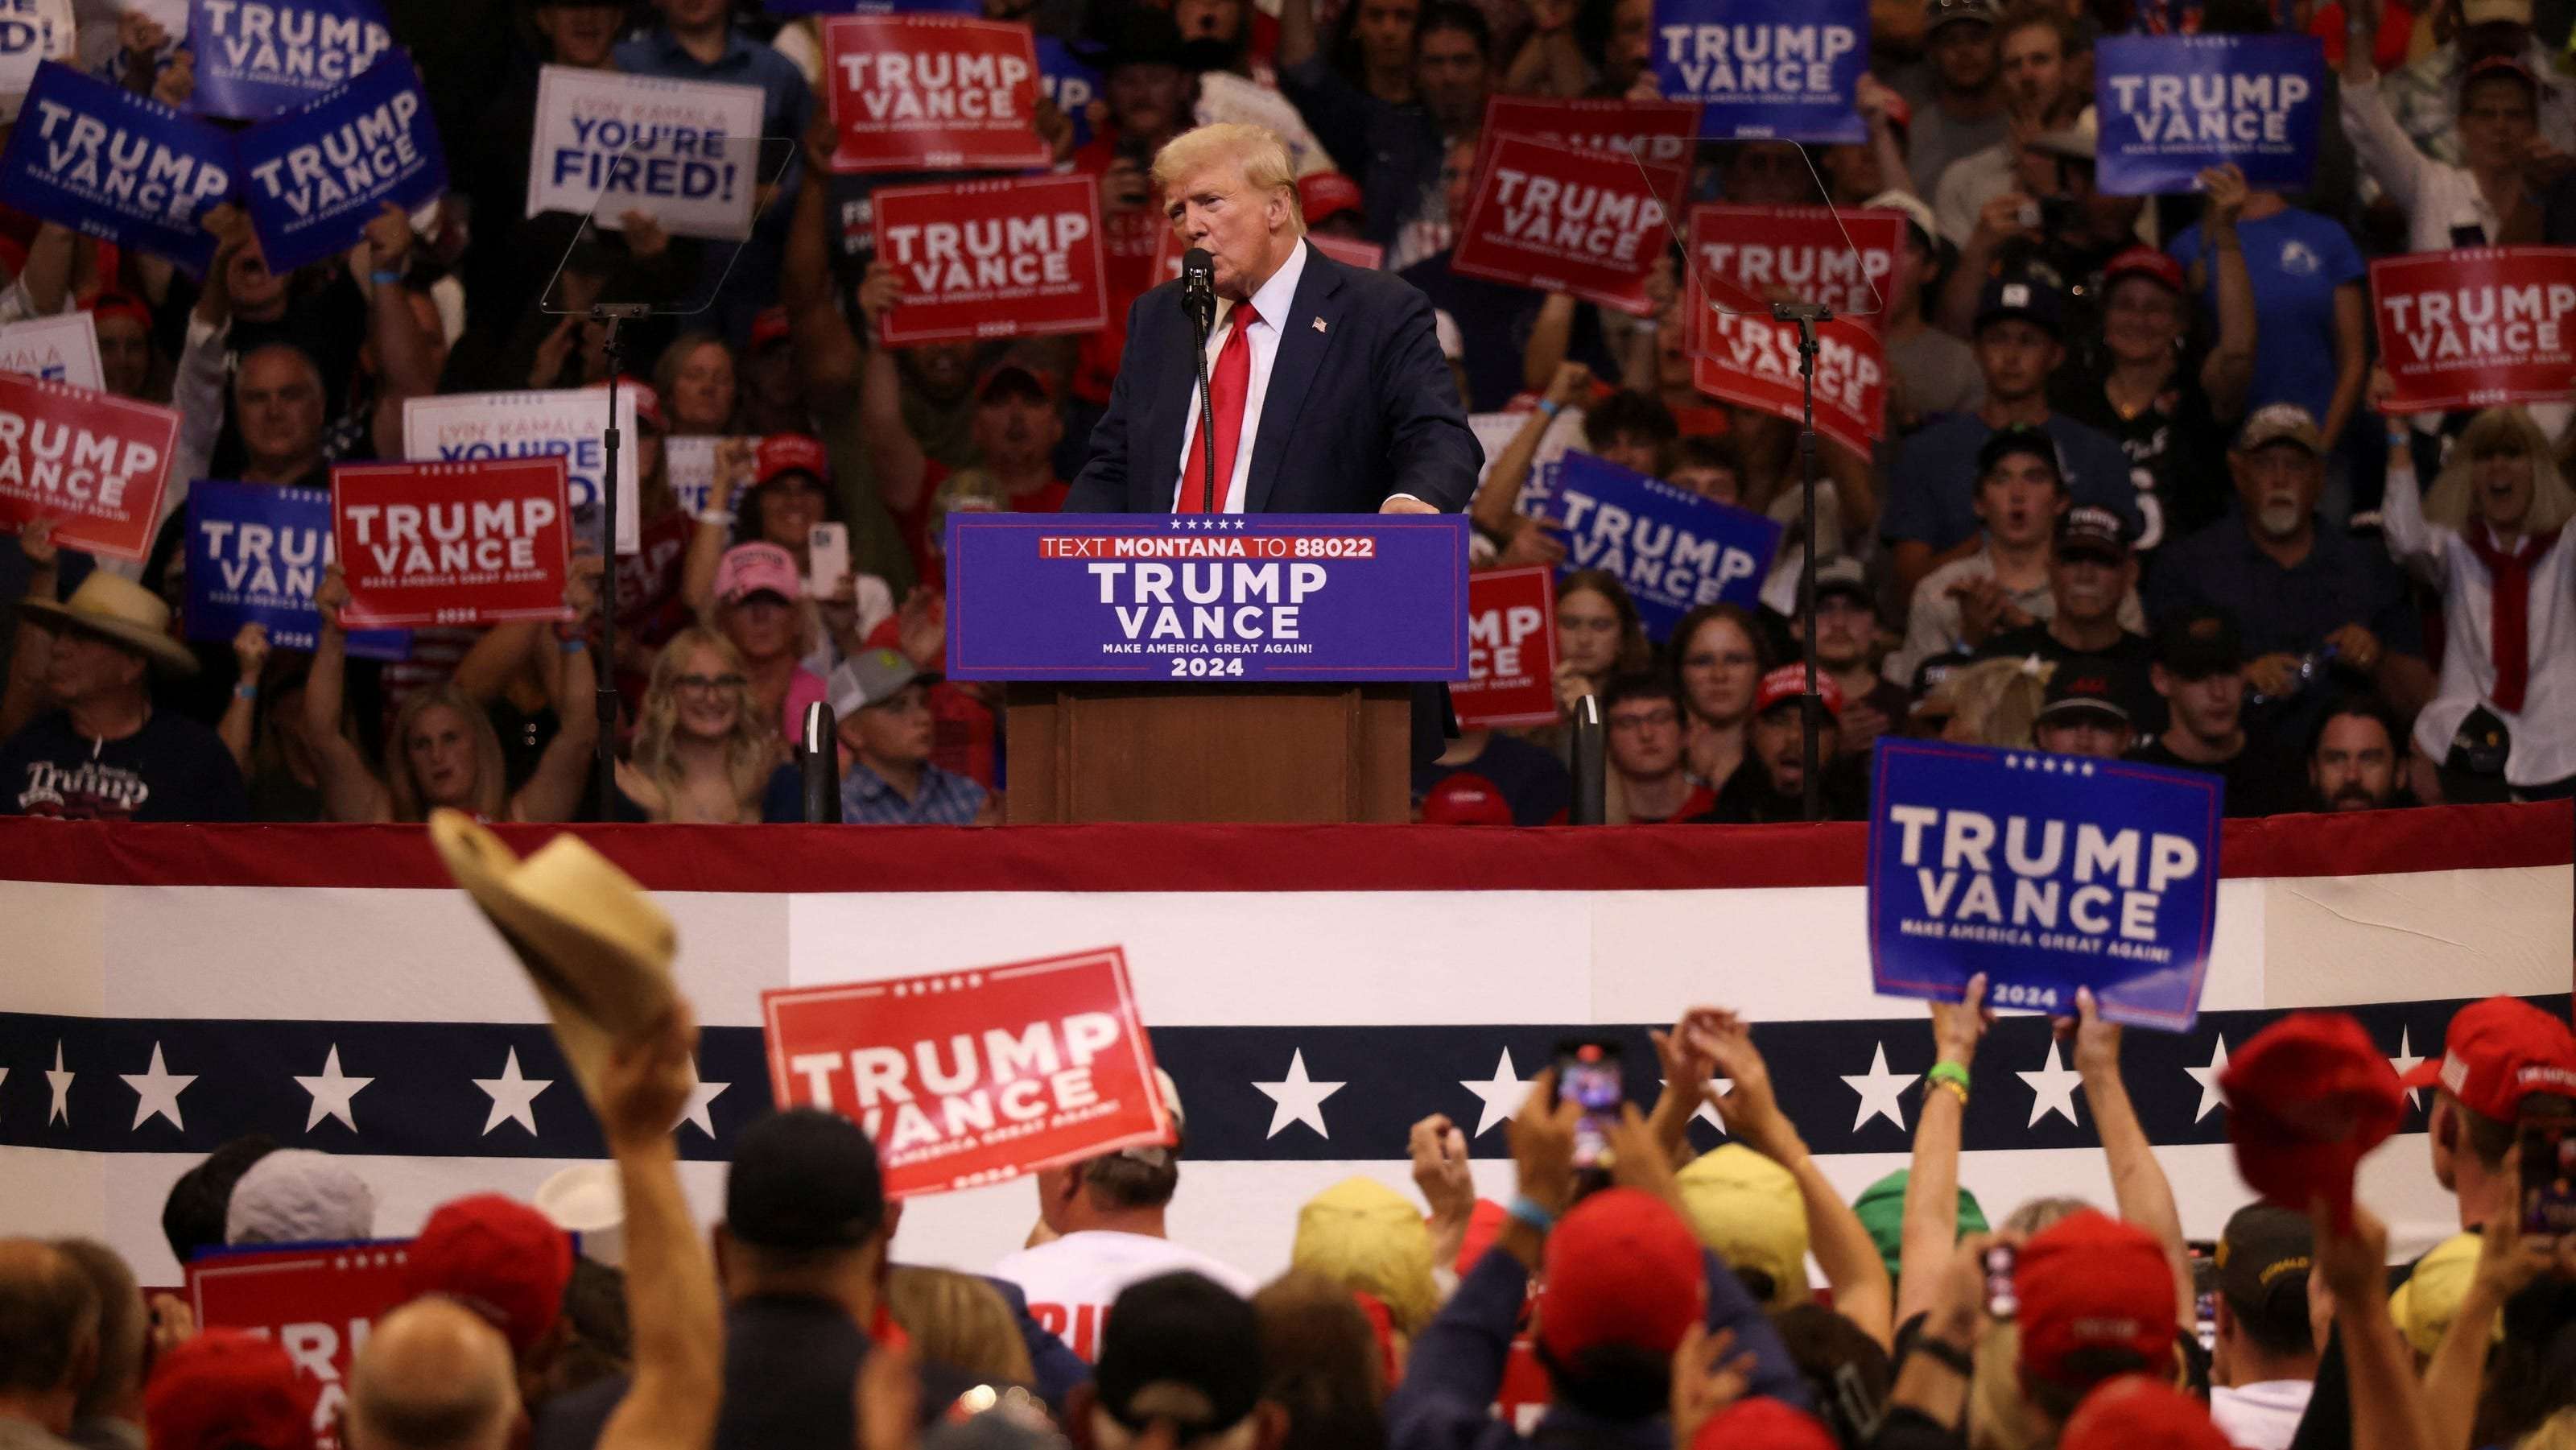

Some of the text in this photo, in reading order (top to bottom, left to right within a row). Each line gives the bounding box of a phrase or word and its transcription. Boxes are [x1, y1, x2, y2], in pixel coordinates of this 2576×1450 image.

[201, 0, 392, 63] TRUMP
[1660, 25, 1856, 63] TRUMP
[223, 35, 372, 81] VANCE
[839, 52, 1028, 90] TRUMP
[1679, 62, 1833, 92] VANCE
[864, 88, 1015, 119] VANCE
[2108, 73, 2310, 114] TRUMP
[251, 90, 418, 199] TRUMP
[572, 117, 728, 158] YOU'RE
[2133, 110, 2287, 142] VANCE
[37, 99, 229, 199] TRUMP
[48, 140, 199, 222] VANCE
[283, 135, 417, 217] VANCE
[554, 149, 736, 201] FIRED!
[1495, 168, 1663, 233] TRUMP
[887, 213, 1090, 264] TRUMP
[1504, 205, 1641, 259] VANCE
[911, 252, 1071, 291] VANCE
[1700, 244, 1891, 283] TRUMP
[2384, 285, 2576, 333] TRUMP
[2409, 321, 2561, 360] VANCE
[0, 412, 157, 479] RUMP
[0, 454, 124, 507] ANCE
[200, 520, 333, 564] TRU
[346, 498, 556, 544] TRUMP
[1562, 491, 1755, 583] TRUMP
[371, 538, 536, 574] VANCE
[1042, 538, 1373, 557] TEXT MONTANA TO 88022
[1572, 532, 1724, 604] VANCE
[221, 559, 315, 599] VAN
[1088, 563, 1327, 604] TRUMP
[1115, 606, 1299, 639] VANCE
[1103, 644, 1312, 654] MAKE AMERICA GREAT AGAIN!
[1171, 658, 1244, 677] 2024
[1889, 804, 2198, 892] TRUMP
[1917, 868, 2160, 941] VANCE
[1901, 919, 2172, 963] MAKE AMERICA GREAT AGAIN!
[1993, 983, 2058, 1006] 2024
[791, 1011, 1120, 1113] TRUMP
[953, 1165, 1019, 1189] 2024
